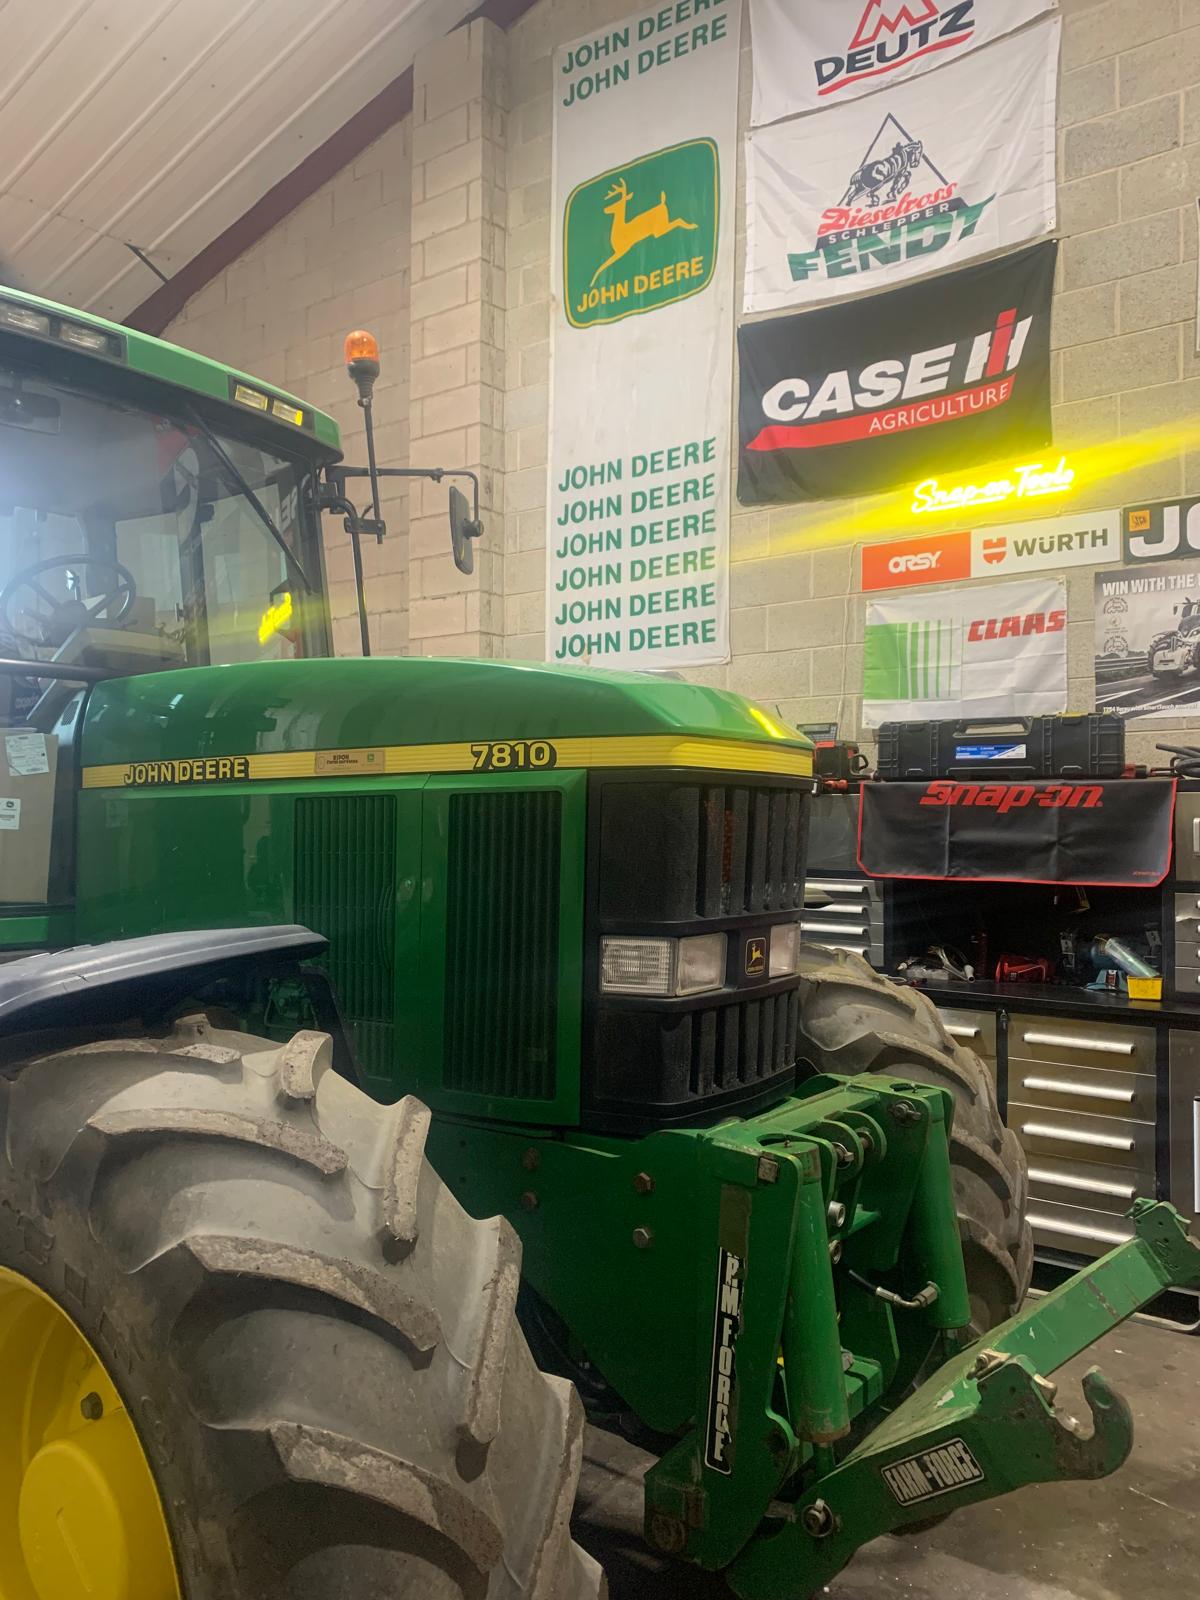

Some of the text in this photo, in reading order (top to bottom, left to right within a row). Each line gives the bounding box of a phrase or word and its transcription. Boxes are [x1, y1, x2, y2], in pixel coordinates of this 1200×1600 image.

[562, 27, 630, 74] JOHN
[562, 14, 728, 107] JOHN DEERE
[814, 1, 975, 86] DEUTZ
[786, 192, 997, 282] FENDT
[828, 203, 950, 244] SCHLEPPER
[577, 256, 704, 313] JOHN DEERE
[762, 343, 957, 422] CASE
[868, 382, 1009, 433] AGRICULTURE
[558, 437, 716, 492] JOHN DEERE
[911, 456, 1075, 513] Snap-on Tools
[557, 473, 715, 526] JOHN DEERE
[556, 509, 716, 558] JOHN DEERE
[1129, 503, 1200, 557] J
[555, 546, 716, 591] JOHN DEERE
[888, 550, 942, 574] ORSY
[1102, 581, 1129, 597] WIN
[1131, 577, 1166, 593] WITH
[1168, 573, 1195, 590] THE
[555, 582, 716, 625] JOHN DEERE
[967, 609, 1066, 642] CLAAS
[555, 618, 716, 659] JOHN DEERE
[124, 757, 249, 785] JOHN DEERE
[470, 740, 556, 770] 7810
